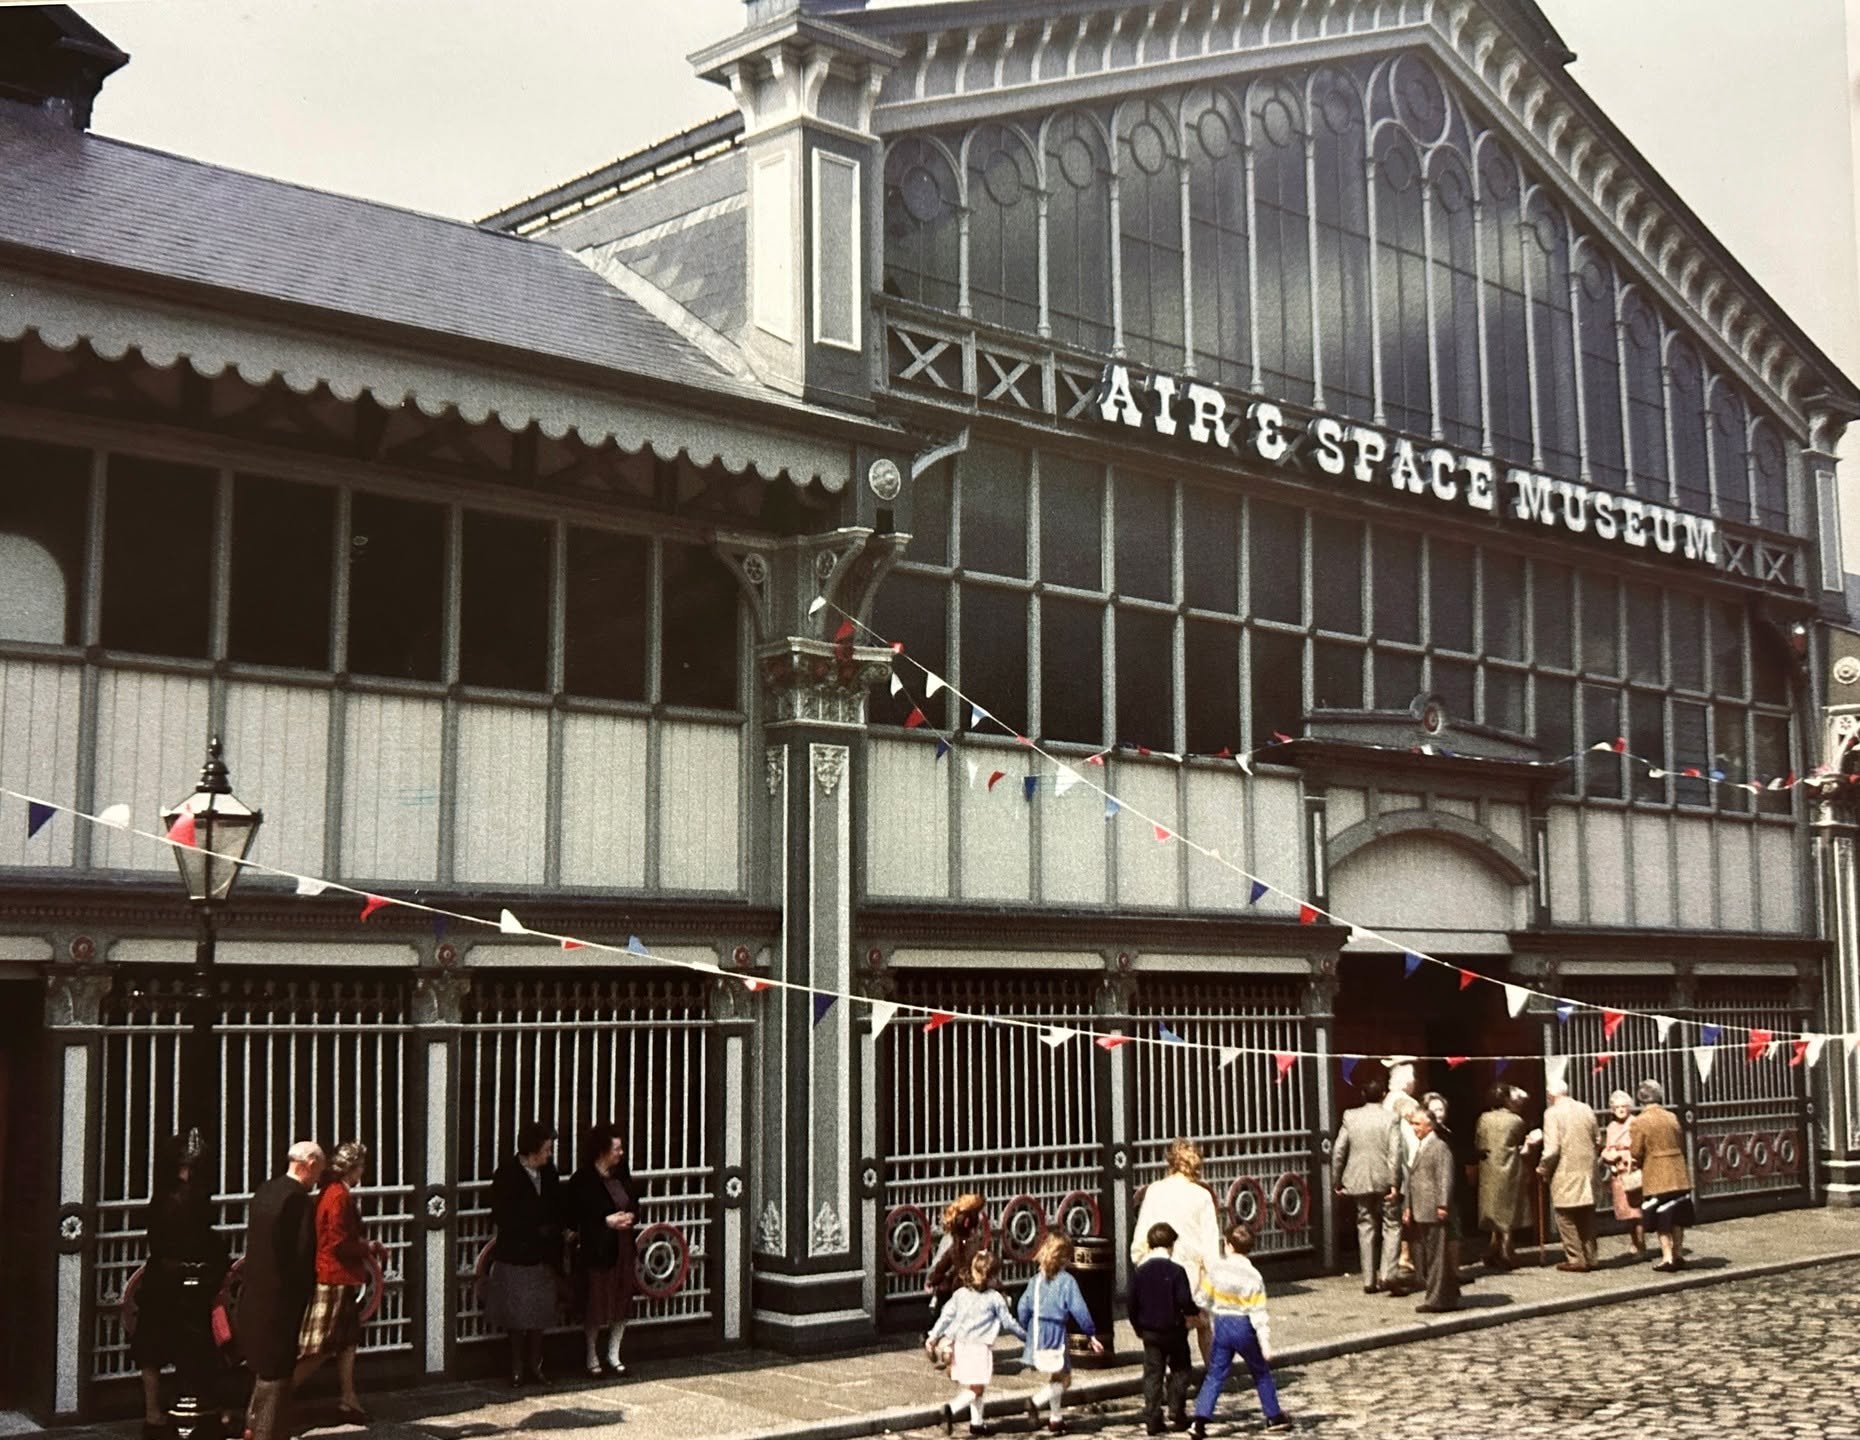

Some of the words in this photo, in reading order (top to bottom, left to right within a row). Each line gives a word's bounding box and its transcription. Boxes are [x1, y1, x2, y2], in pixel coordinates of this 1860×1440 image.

[1098, 364, 1231, 449] AIR
[1249, 402, 1288, 461] &
[1309, 417, 1494, 511] SPACE
[1507, 468, 1718, 565] MUSEUM
